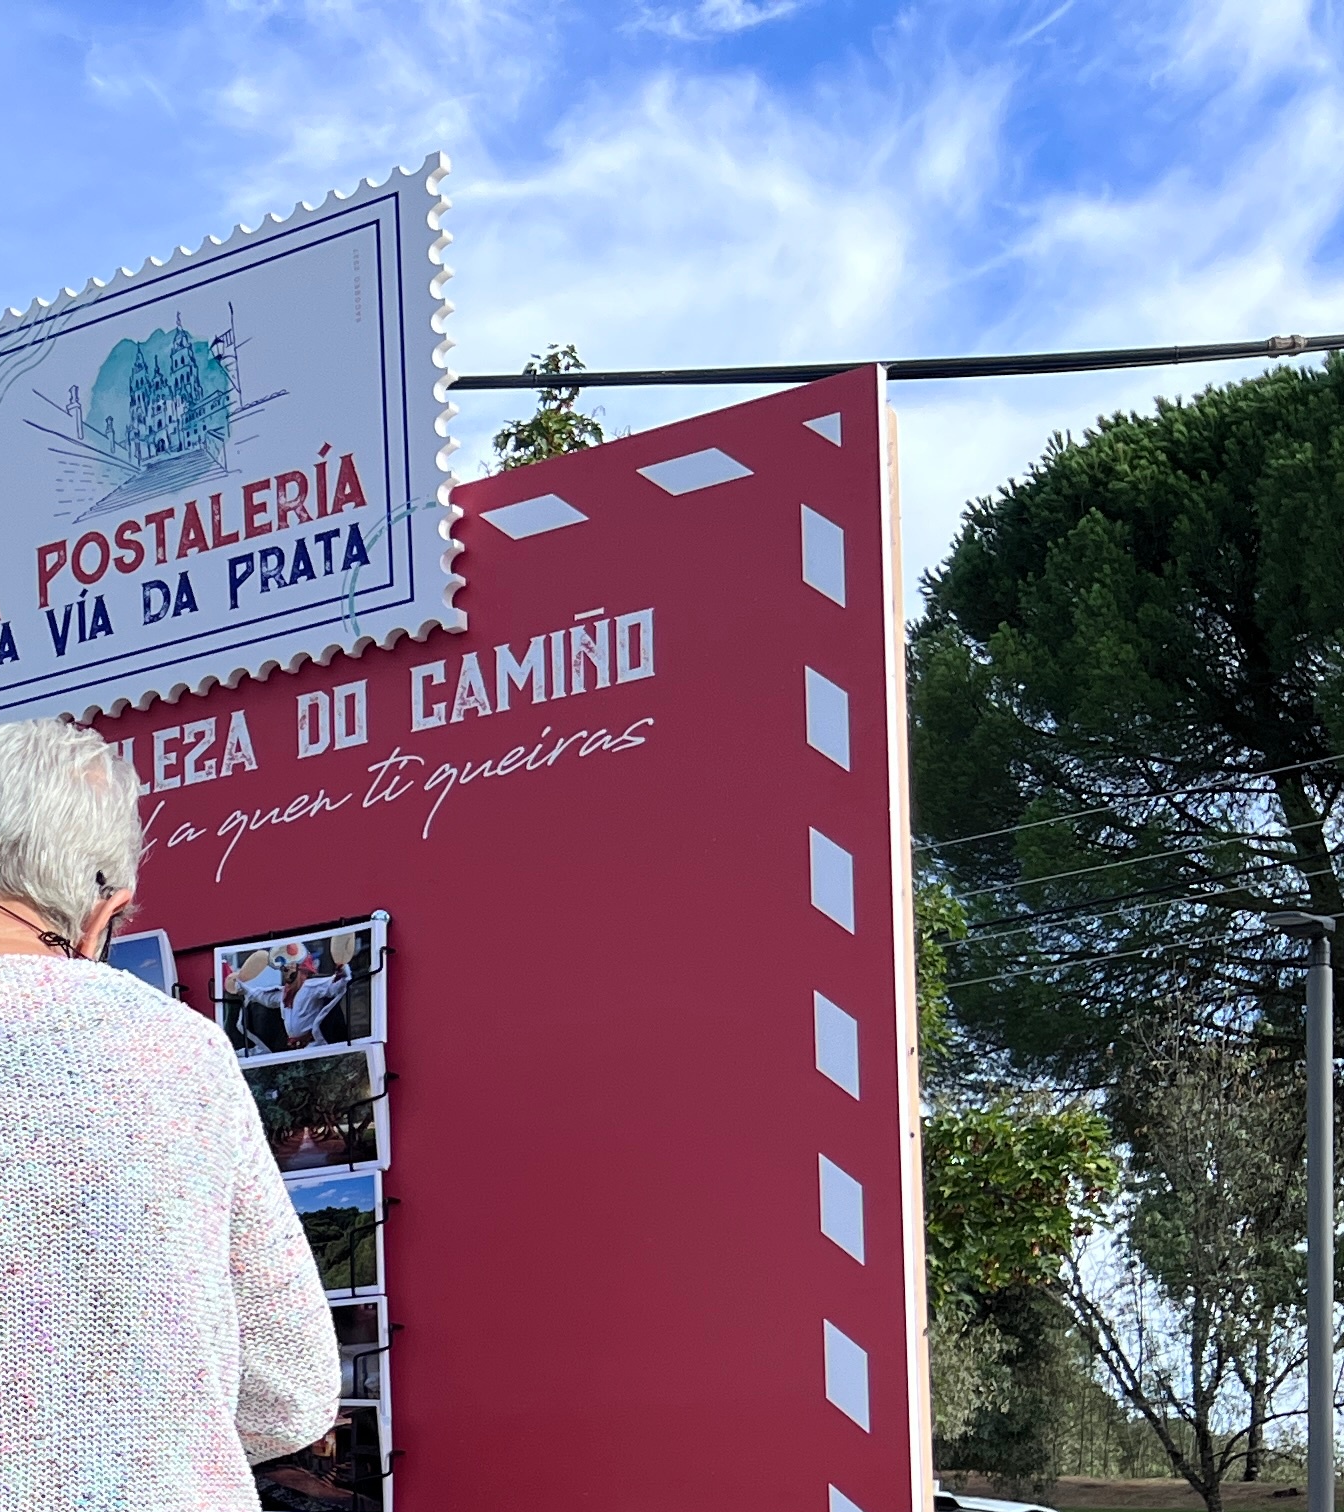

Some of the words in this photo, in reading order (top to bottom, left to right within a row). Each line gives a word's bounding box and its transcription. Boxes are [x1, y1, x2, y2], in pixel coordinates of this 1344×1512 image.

[35, 441, 368, 609] POSTALERÍA
[45, 587, 114, 658] VÍA
[142, 571, 199, 626] DA
[227, 522, 371, 610] PRATA
[296, 678, 369, 760] DO
[409, 606, 656, 733] CAMIÑO
[167, 822, 208, 848] a
[216, 789, 353, 883] quen
[361, 746, 425, 808] ti
[421, 717, 655, 840] queiras
